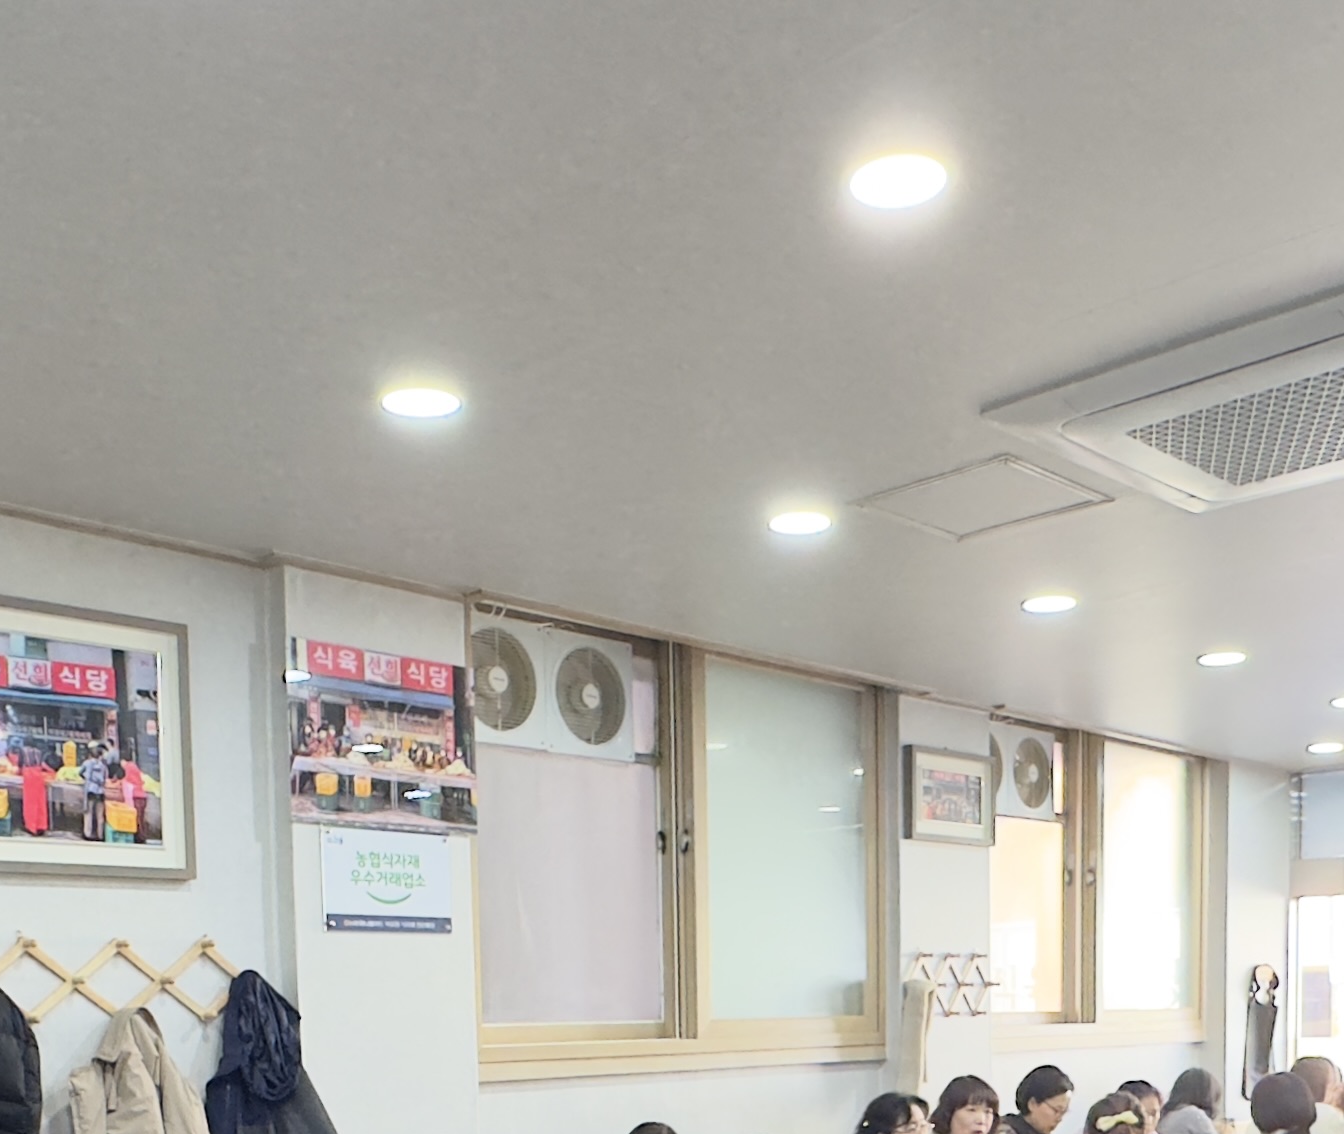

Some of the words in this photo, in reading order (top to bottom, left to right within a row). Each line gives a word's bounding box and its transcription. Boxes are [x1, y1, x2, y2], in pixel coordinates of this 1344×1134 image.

[11, 660, 51, 686] 선희
[58, 664, 109, 691] 식당
[314, 646, 358, 674] 식육
[407, 662, 449, 689] 식당
[356, 851, 420, 869] 농협식자재
[350, 869, 426, 889] 우수거래업소
